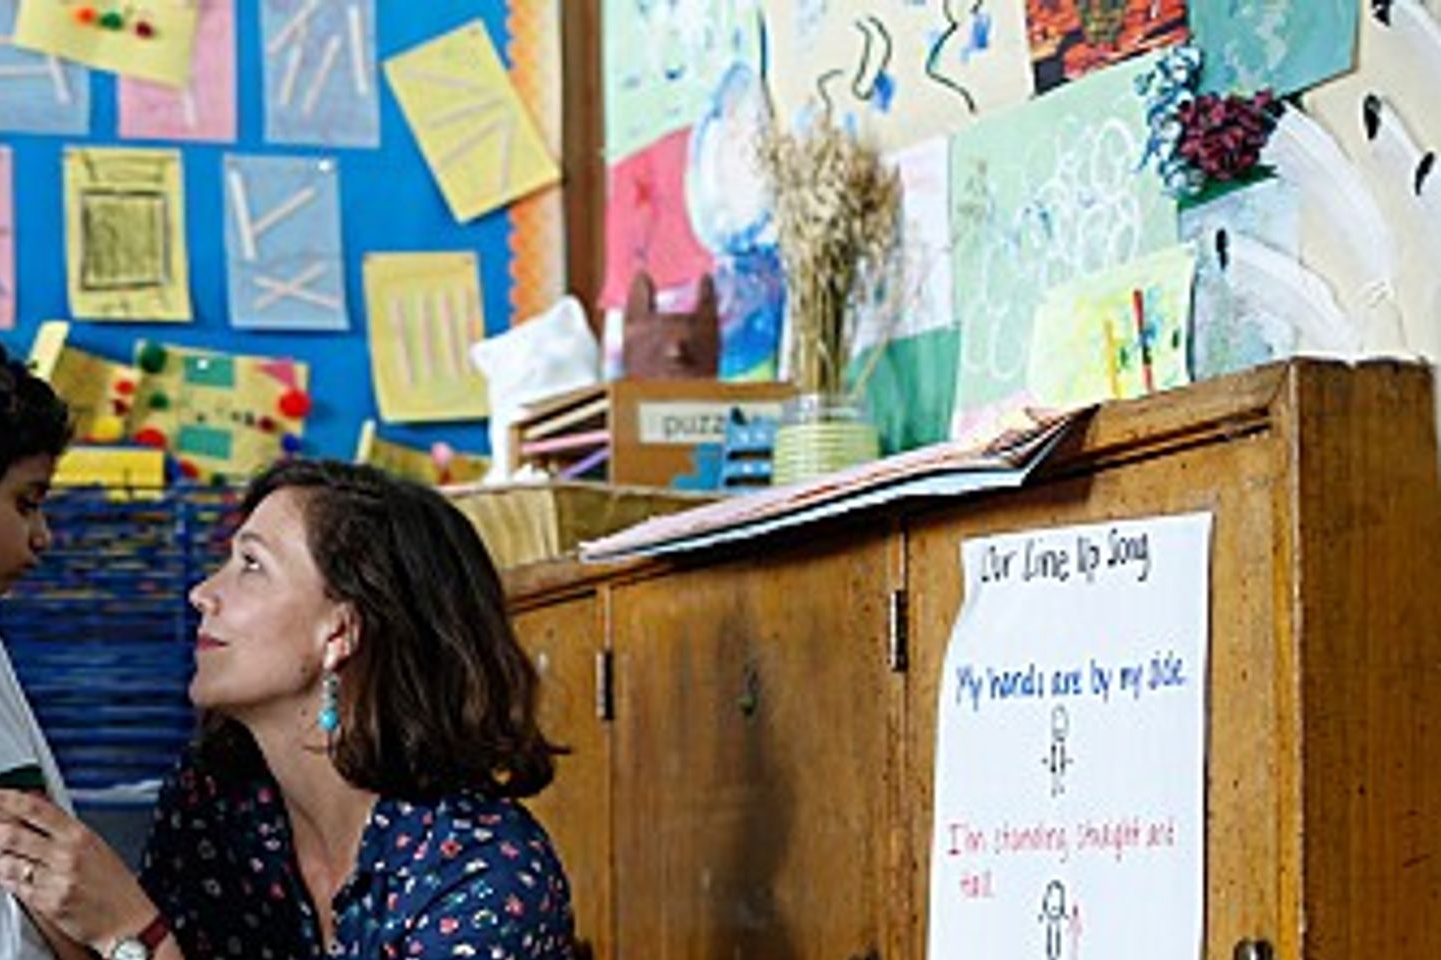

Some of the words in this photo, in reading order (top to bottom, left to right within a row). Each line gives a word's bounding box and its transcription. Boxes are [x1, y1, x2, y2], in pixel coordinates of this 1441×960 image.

[663, 414, 727, 438] puzz
[1023, 536, 1070, 582] Line
[1077, 535, 1100, 582] Up
[1107, 527, 1151, 582] Song
[956, 664, 982, 712] My
[987, 662, 1044, 699] hands
[1052, 669, 1082, 696] are
[1091, 658, 1112, 703] by
[1120, 663, 1143, 700] my
